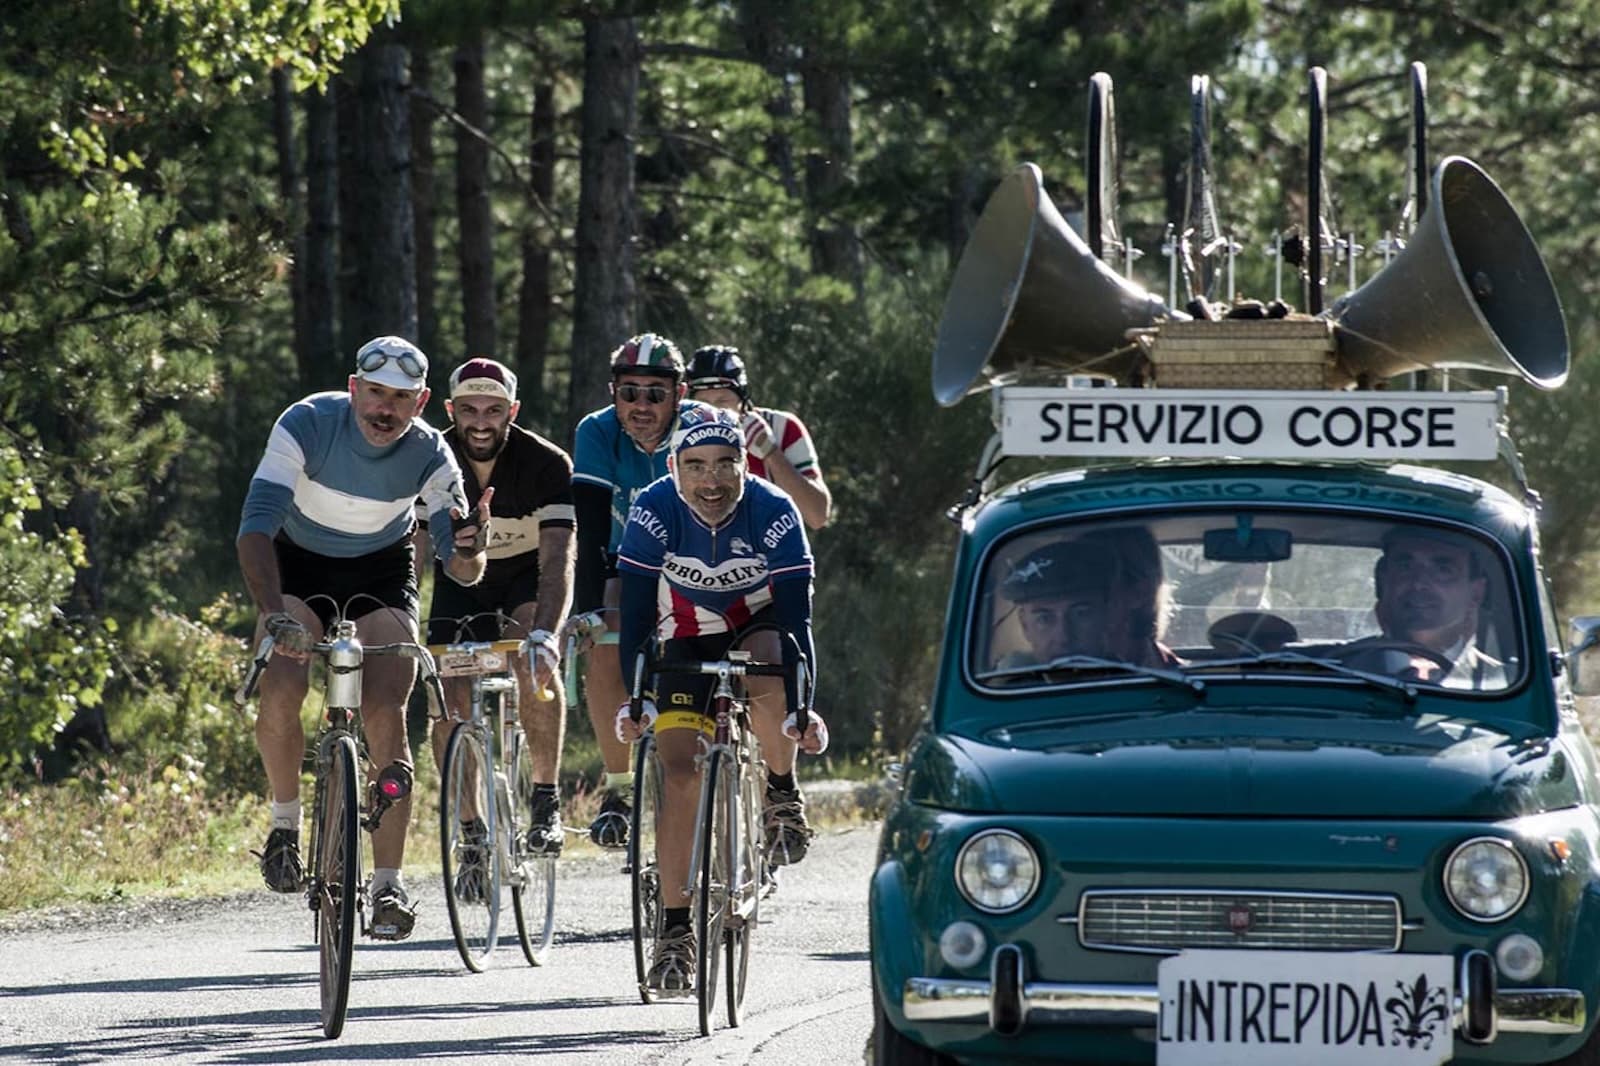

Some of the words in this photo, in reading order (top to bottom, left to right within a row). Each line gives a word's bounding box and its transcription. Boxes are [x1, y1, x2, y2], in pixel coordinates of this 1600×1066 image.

[685, 427, 738, 446] BROOKLYN
[1039, 402, 1263, 445] SERVIZIO
[1288, 405, 1456, 448] CORSE
[665, 562, 767, 586] BROOKLYN
